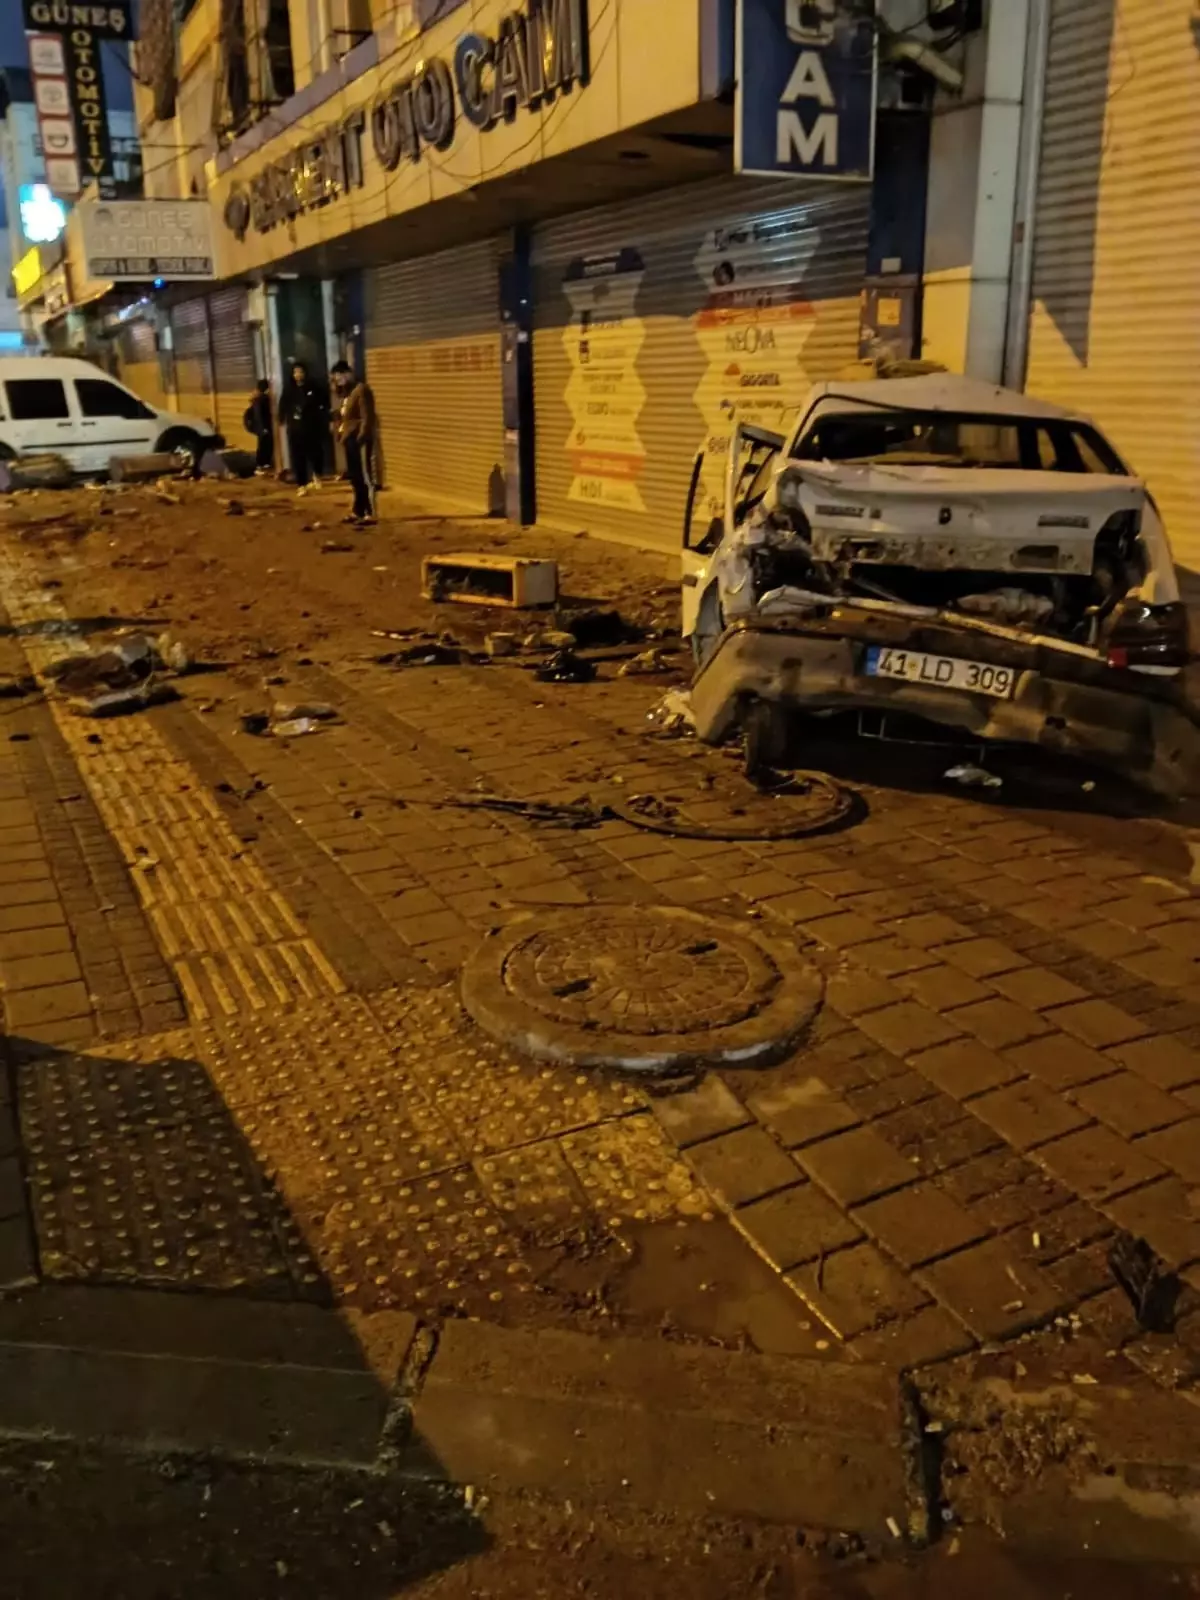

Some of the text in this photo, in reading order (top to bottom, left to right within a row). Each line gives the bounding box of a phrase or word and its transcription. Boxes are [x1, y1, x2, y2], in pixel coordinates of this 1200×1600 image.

[31, 0, 126, 32] GÜNEŞ
[372, 57, 456, 171] OTO
[454, 0, 591, 131] CAM
[879, 650, 1010, 694] 41 LD 309
